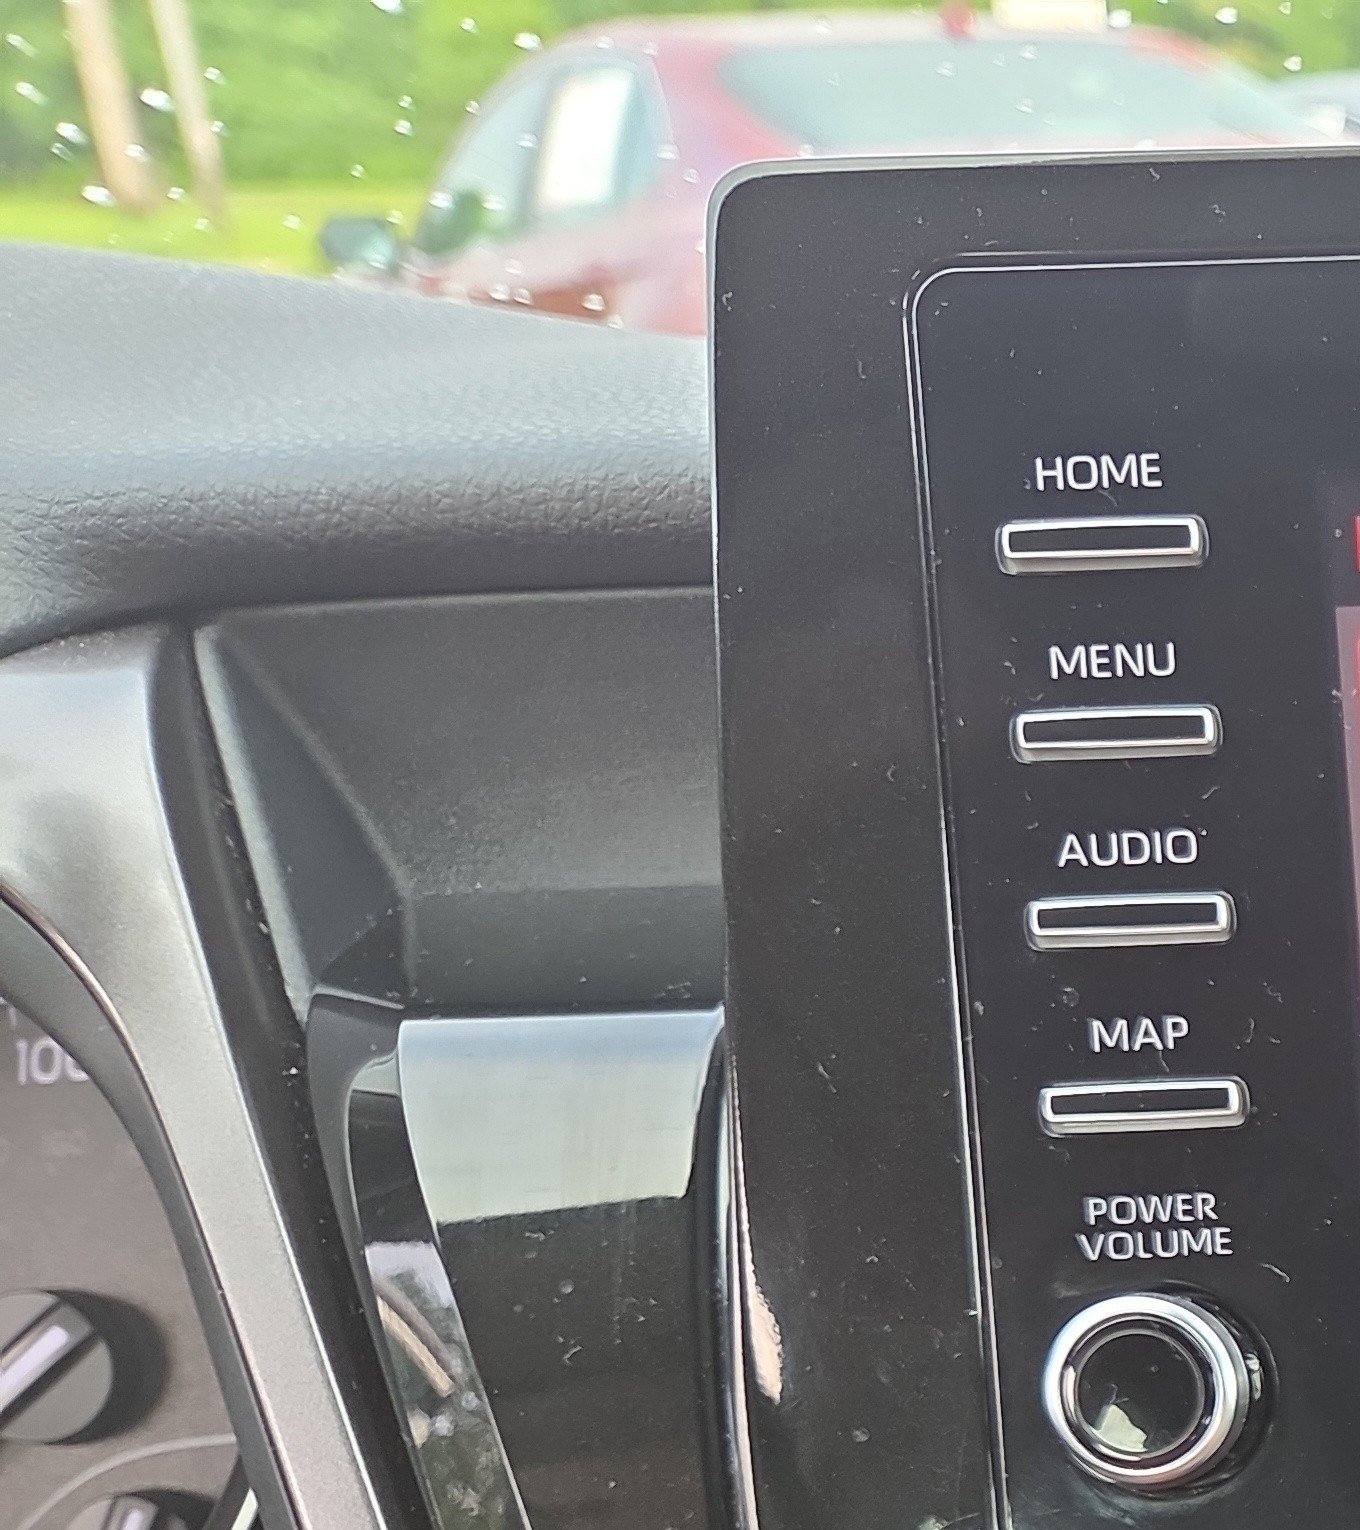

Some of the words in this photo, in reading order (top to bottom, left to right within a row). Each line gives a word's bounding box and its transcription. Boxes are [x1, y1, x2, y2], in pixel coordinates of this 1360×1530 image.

[1034, 453, 1162, 491] HOME
[1050, 643, 1176, 680] MENU
[1058, 829, 1198, 867] AUDIO
[1090, 1016, 1189, 1052] MAP
[1085, 1193, 1218, 1225] POWER
[1077, 1227, 1233, 1260] VOLUME
